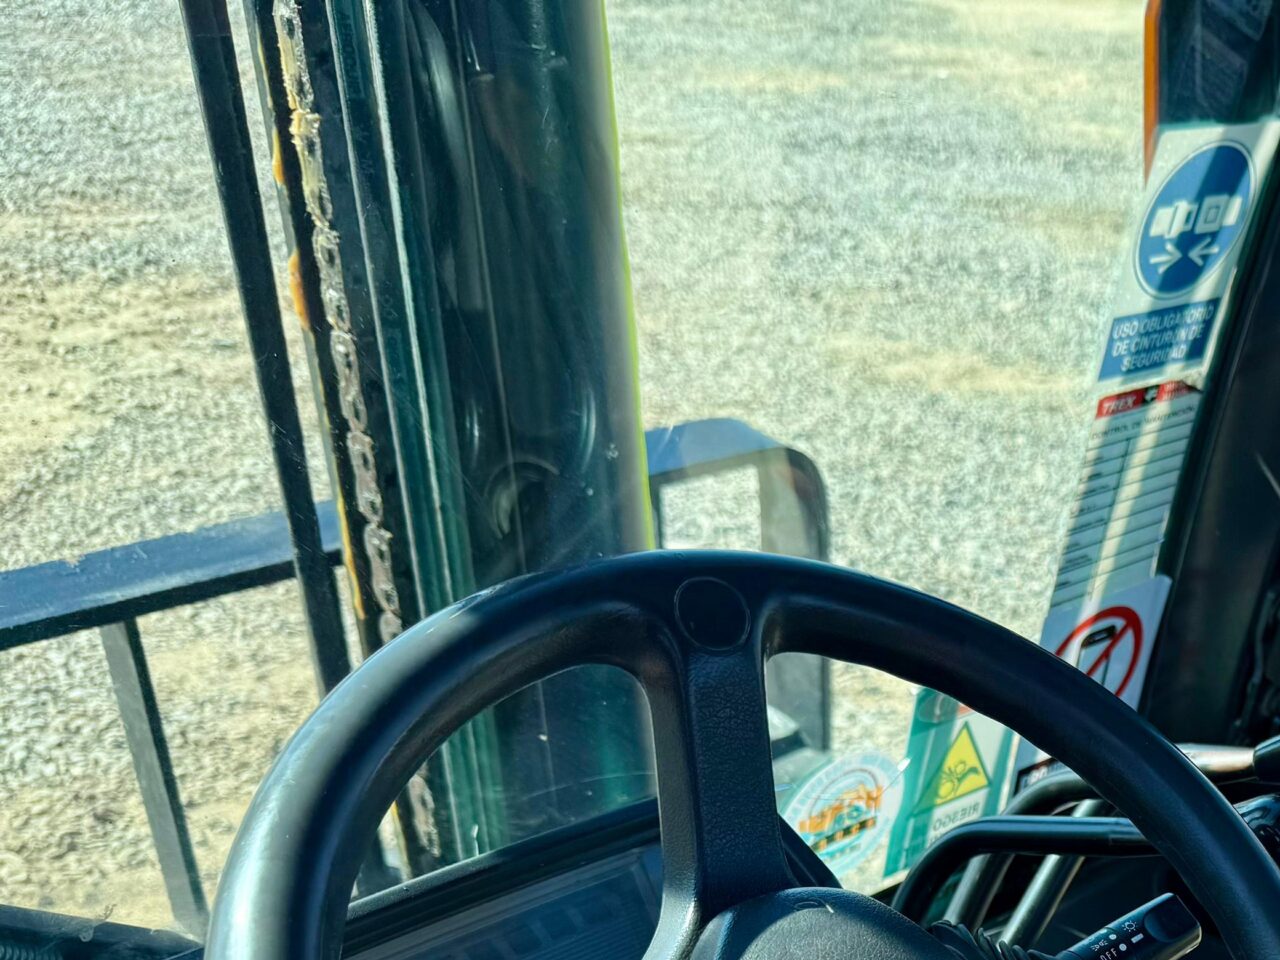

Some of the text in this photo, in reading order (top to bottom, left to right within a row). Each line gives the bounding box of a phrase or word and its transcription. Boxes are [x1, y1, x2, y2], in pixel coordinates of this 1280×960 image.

[1112, 304, 1215, 340] USO OBLIGATORIO
[1112, 340, 1129, 357] DE
